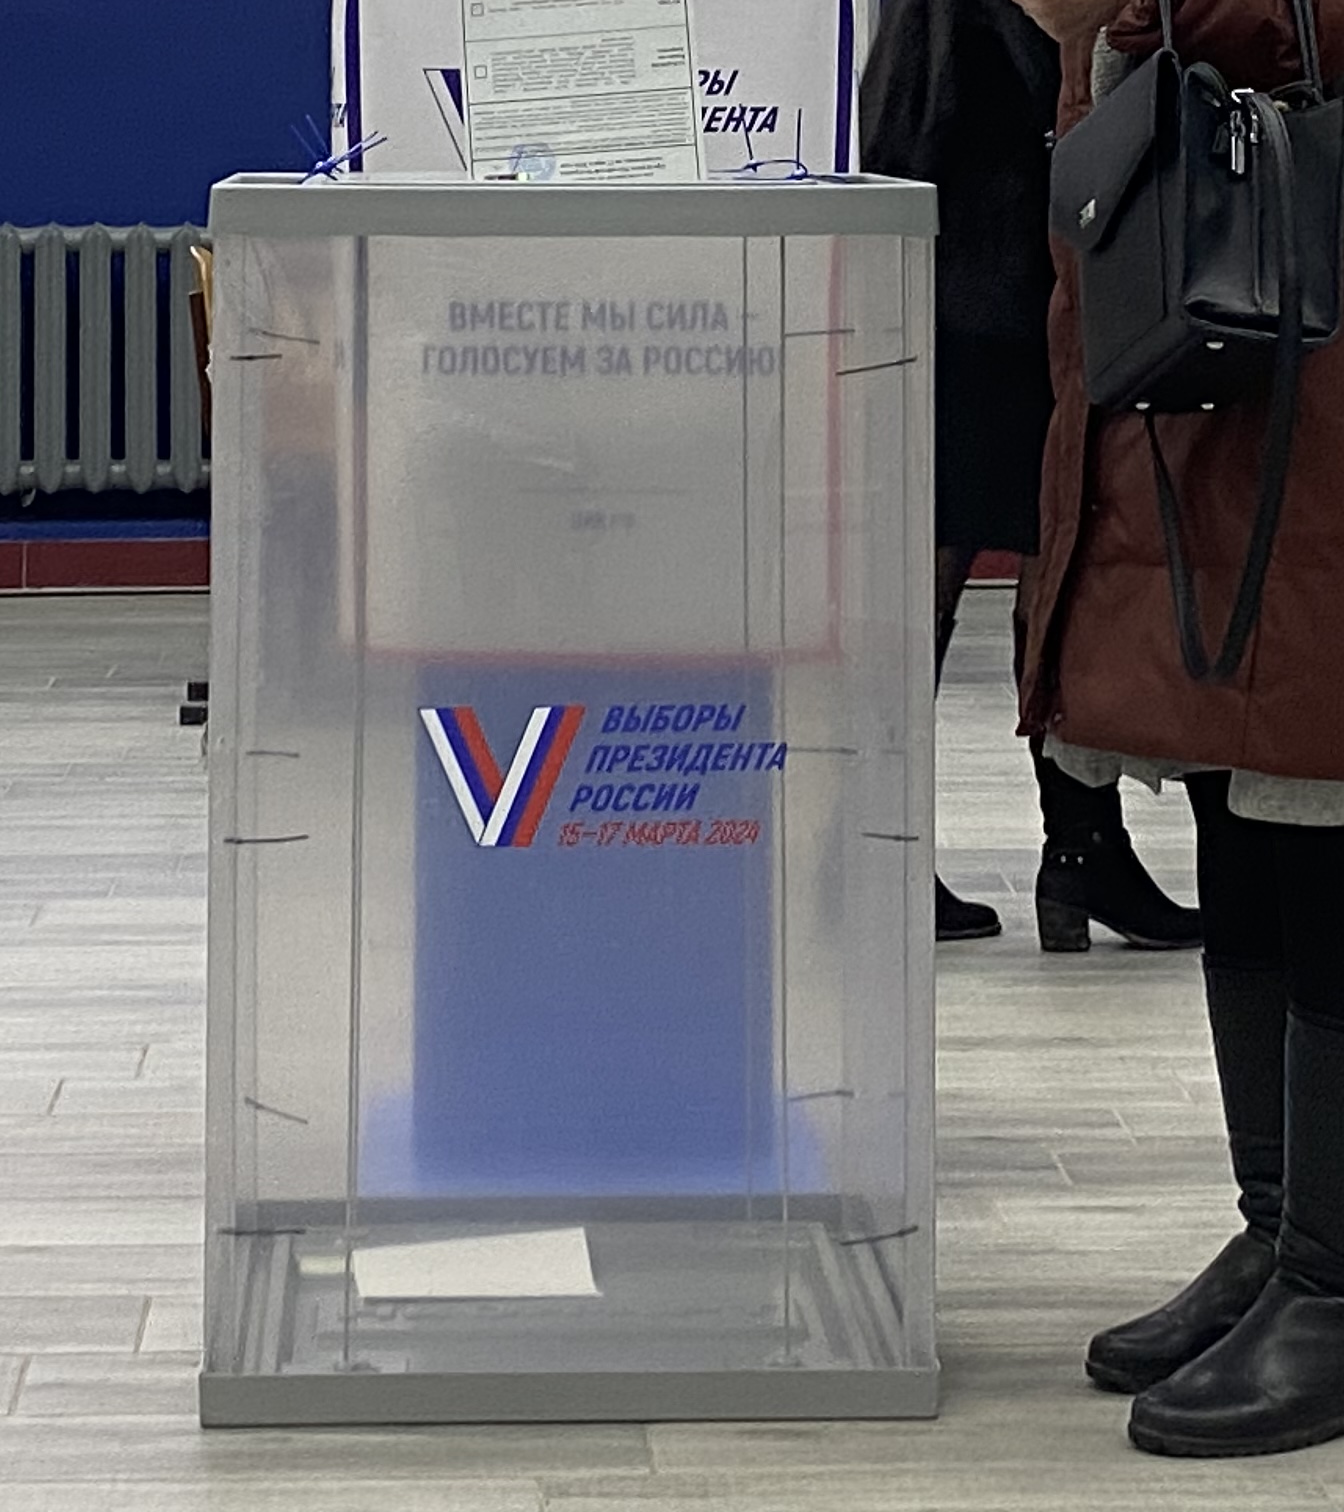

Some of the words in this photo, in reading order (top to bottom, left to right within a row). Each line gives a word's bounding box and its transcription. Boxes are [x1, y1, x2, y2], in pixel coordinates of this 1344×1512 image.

[701, 105, 779, 133] ЕНТА
[448, 301, 570, 332] ВМЕСТЕ
[581, 301, 635, 332] МЫ
[646, 300, 729, 332] СИЛА
[421, 345, 587, 376] ГОЛОСУЕМ
[596, 345, 632, 376] ЗА
[643, 345, 776, 376] РОССИЮ
[601, 704, 747, 734] ВЫБОРЫ
[584, 742, 788, 776] ПРЕЗИДЕНТА
[569, 783, 701, 813] РОССИИ
[622, 819, 702, 847] МАРТА
[704, 819, 760, 846] 2024
